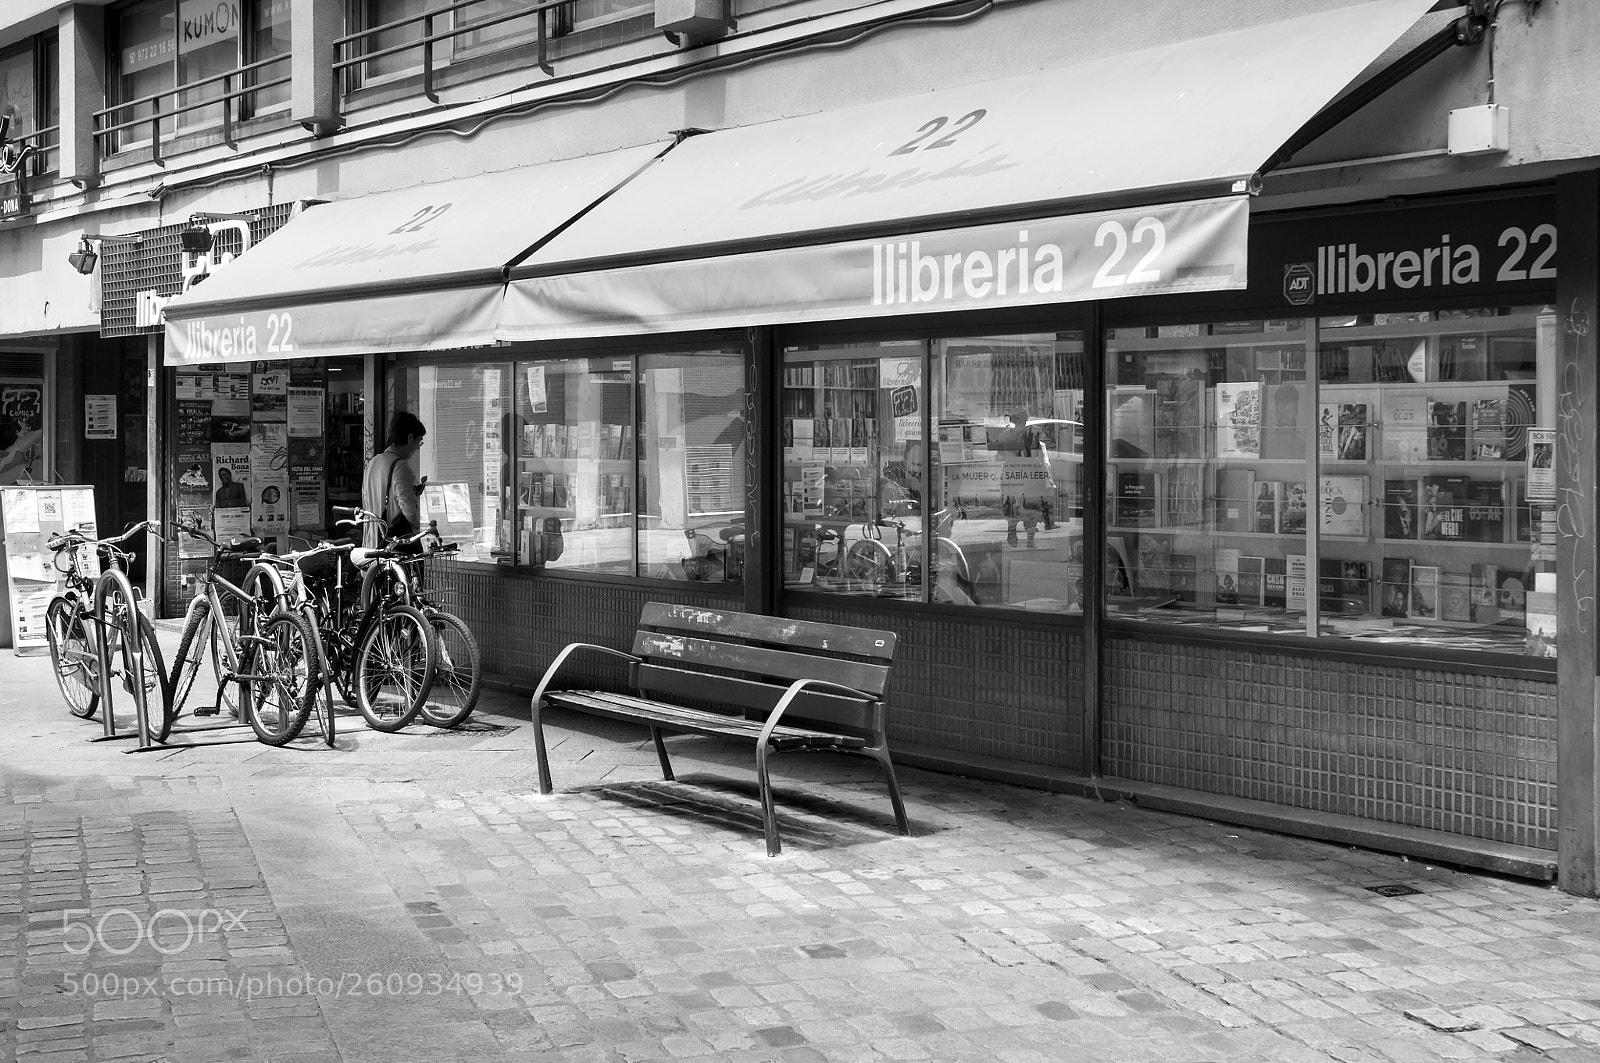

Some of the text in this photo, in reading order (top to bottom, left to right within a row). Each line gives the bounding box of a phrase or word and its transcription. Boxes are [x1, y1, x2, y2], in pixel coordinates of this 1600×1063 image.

[184, 2, 239, 42] KUMON
[137, 47, 149, 62] 972
[149, 44, 158, 58] 22
[886, 108, 987, 157] 22
[387, 202, 453, 235] 22
[871, 216, 1167, 306] llibreria 22
[1317, 223, 1558, 295] llibreria 22
[1289, 276, 1310, 291] ADT
[183, 311, 294, 360] llibreria 22
[215, 455, 249, 464] Richard
[962, 472, 989, 480] MUJER
[1005, 469, 1029, 480] SABÍA
[1030, 471, 1049, 480] LEER
[1266, 574, 1285, 585] CASH
